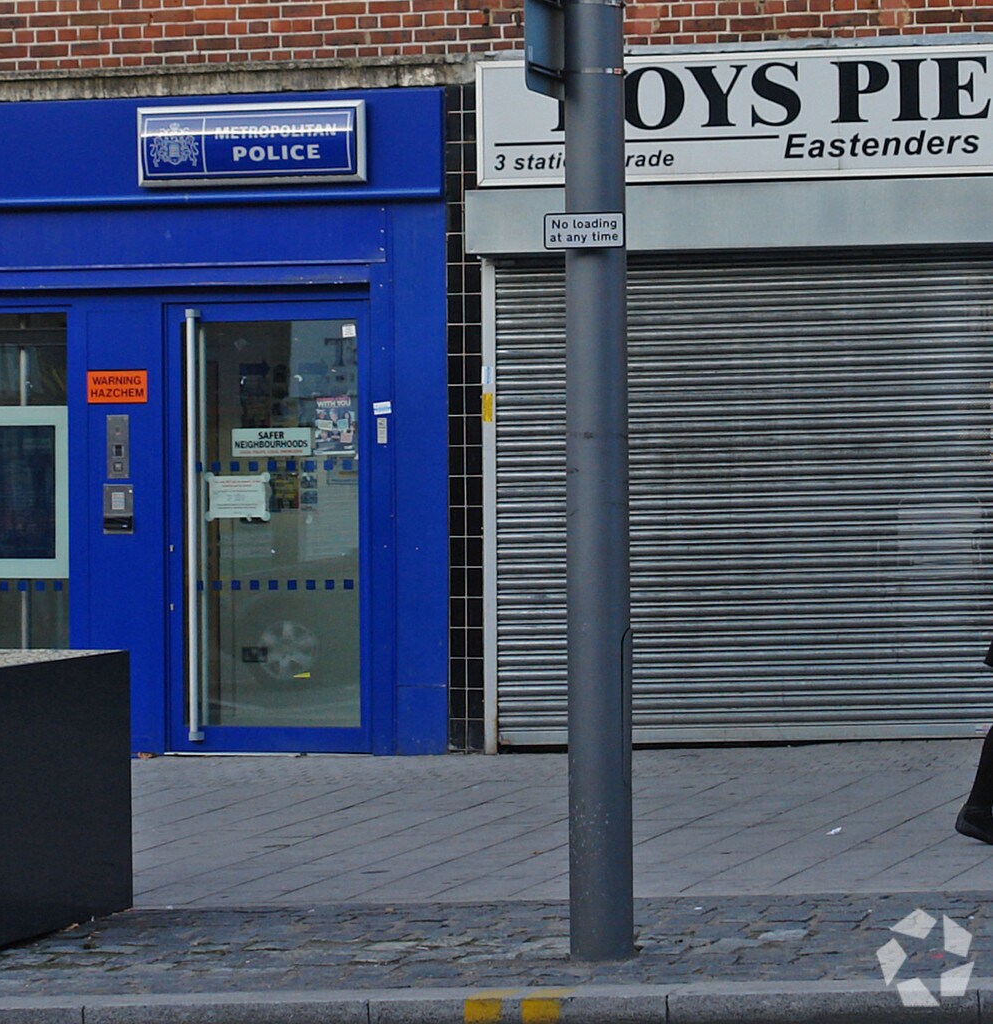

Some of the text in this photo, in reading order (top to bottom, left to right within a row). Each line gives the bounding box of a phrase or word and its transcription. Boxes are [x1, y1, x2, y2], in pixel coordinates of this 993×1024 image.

[551, 56, 991, 132] OYS PIE
[214, 123, 338, 140] METROPOLITAN
[784, 130, 980, 159] Eastenders
[232, 144, 321, 162] POLICE
[494, 154, 506, 171] 3
[551, 218, 617, 230] No loading
[550, 231, 619, 244] at any time
[92, 375, 141, 385] WARNING
[90, 388, 144, 398] HAZCHEM
[258, 431, 285, 439] SAFER
[234, 440, 309, 449] NEIGHBOURHOODS
